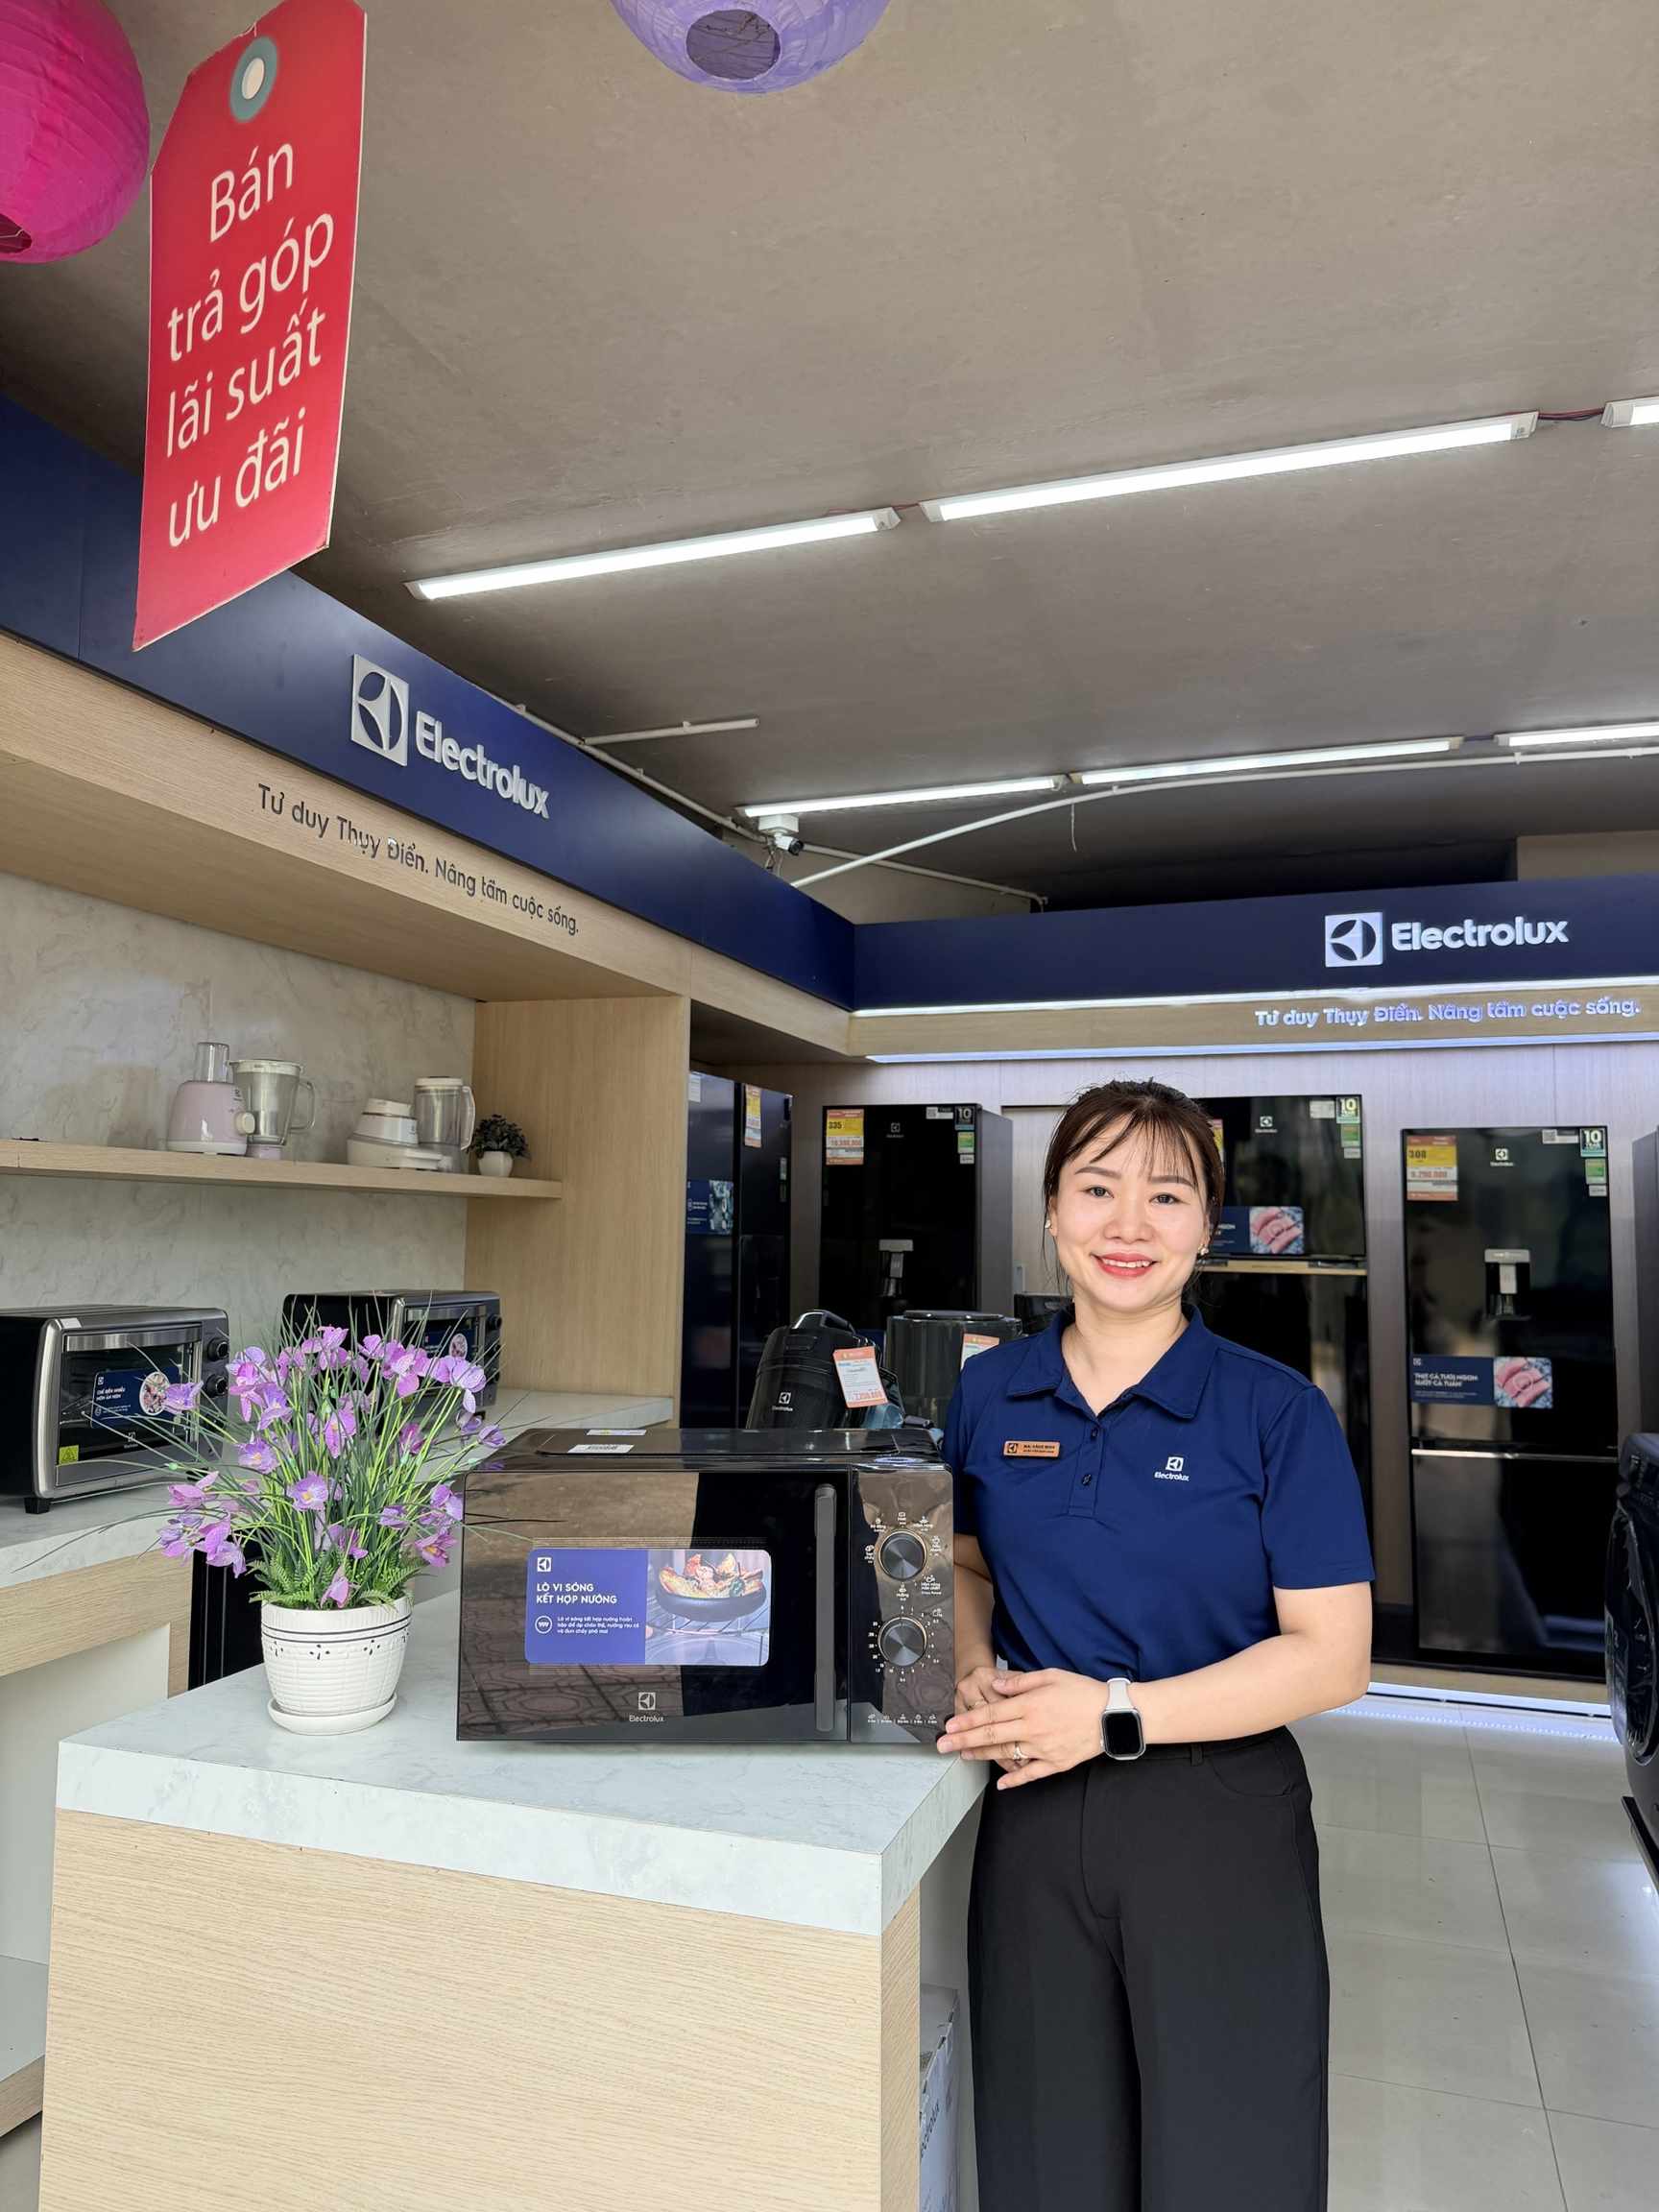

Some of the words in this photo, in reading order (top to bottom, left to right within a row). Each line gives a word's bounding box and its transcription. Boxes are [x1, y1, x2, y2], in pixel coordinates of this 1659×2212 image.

[209, 142, 294, 243] Bán
[167, 269, 224, 363] trả
[239, 211, 334, 334] góp
[167, 370, 211, 458] lãi
[227, 298, 325, 421] suất
[168, 471, 222, 547] ưu
[235, 408, 305, 508] đãi
[416, 710, 549, 819] Electrolux
[258, 783, 285, 815] Tư
[292, 801, 329, 838] duy
[337, 815, 380, 858] Thụy
[386, 836, 428, 874] Điển.
[435, 857, 476, 897] Nâng
[482, 876, 508, 905] tầm
[512, 897, 543, 920] cuộc
[547, 905, 579, 936] sống.
[1391, 916, 1570, 951] Electrolux
[1254, 1009, 1280, 1026] Tư
[1283, 1008, 1319, 1028] duy
[1323, 1007, 1369, 1026] Thụy
[1428, 1002, 1483, 1023] Nâng
[1487, 999, 1527, 1019] tầm
[1531, 999, 1581, 1019] cuộc
[1585, 995, 1641, 1018] sống.
[1584, 1130, 1602, 1143] 10
[1154, 1471, 1190, 1481] Electrolux
[537, 1581, 550, 1592] LÒ
[553, 1583, 563, 1592] VI
[565, 1581, 594, 1592] SÓNG
[537, 1592, 554, 1603] KẾT
[556, 1594, 578, 1605] HỢP
[581, 1594, 617, 1604] NƯỚNG
